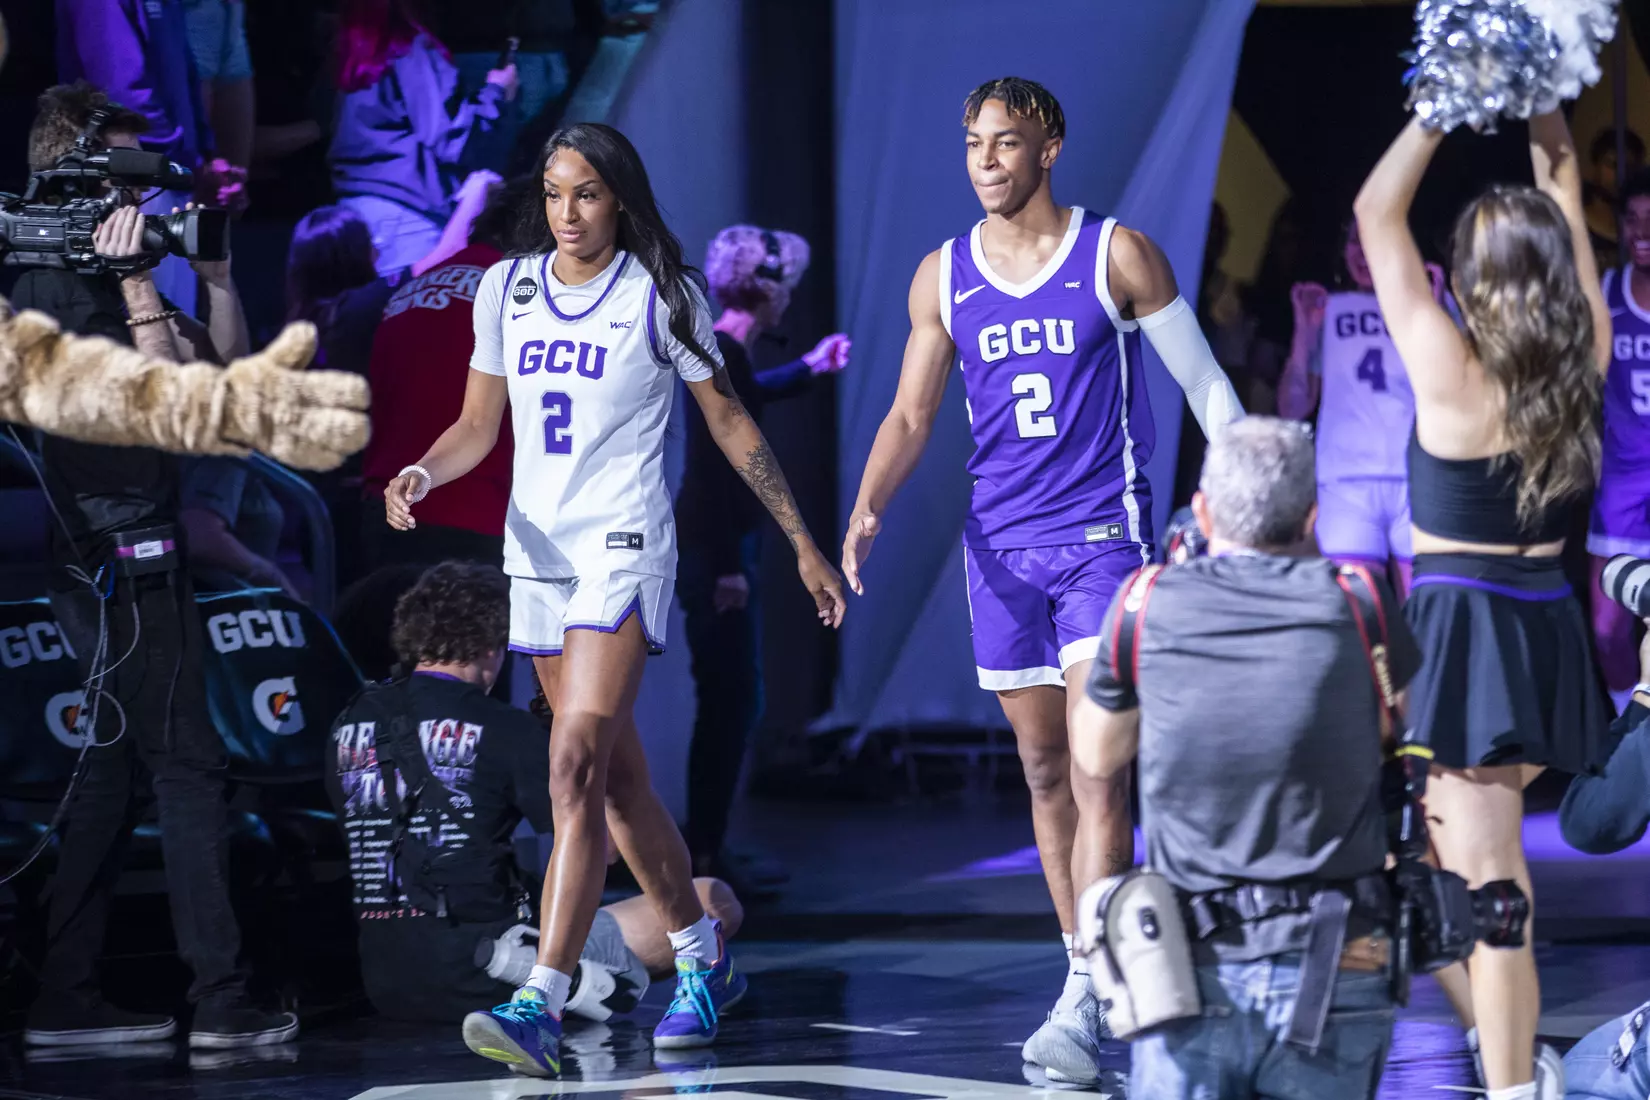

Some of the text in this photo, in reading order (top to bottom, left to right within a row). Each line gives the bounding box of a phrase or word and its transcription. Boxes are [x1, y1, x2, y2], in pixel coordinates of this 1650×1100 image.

[514, 288, 536, 297] GOD
[609, 320, 632, 330] WAC
[978, 318, 1076, 364] GCU
[517, 339, 608, 381] GCU
[1357, 348, 1387, 391] 4
[1011, 372, 1058, 438] 2
[1630, 370, 1650, 416] 5
[540, 389, 573, 456] 2
[631, 537, 639, 545] M
[1110, 527, 1119, 535] M
[207, 610, 307, 654] GCU
